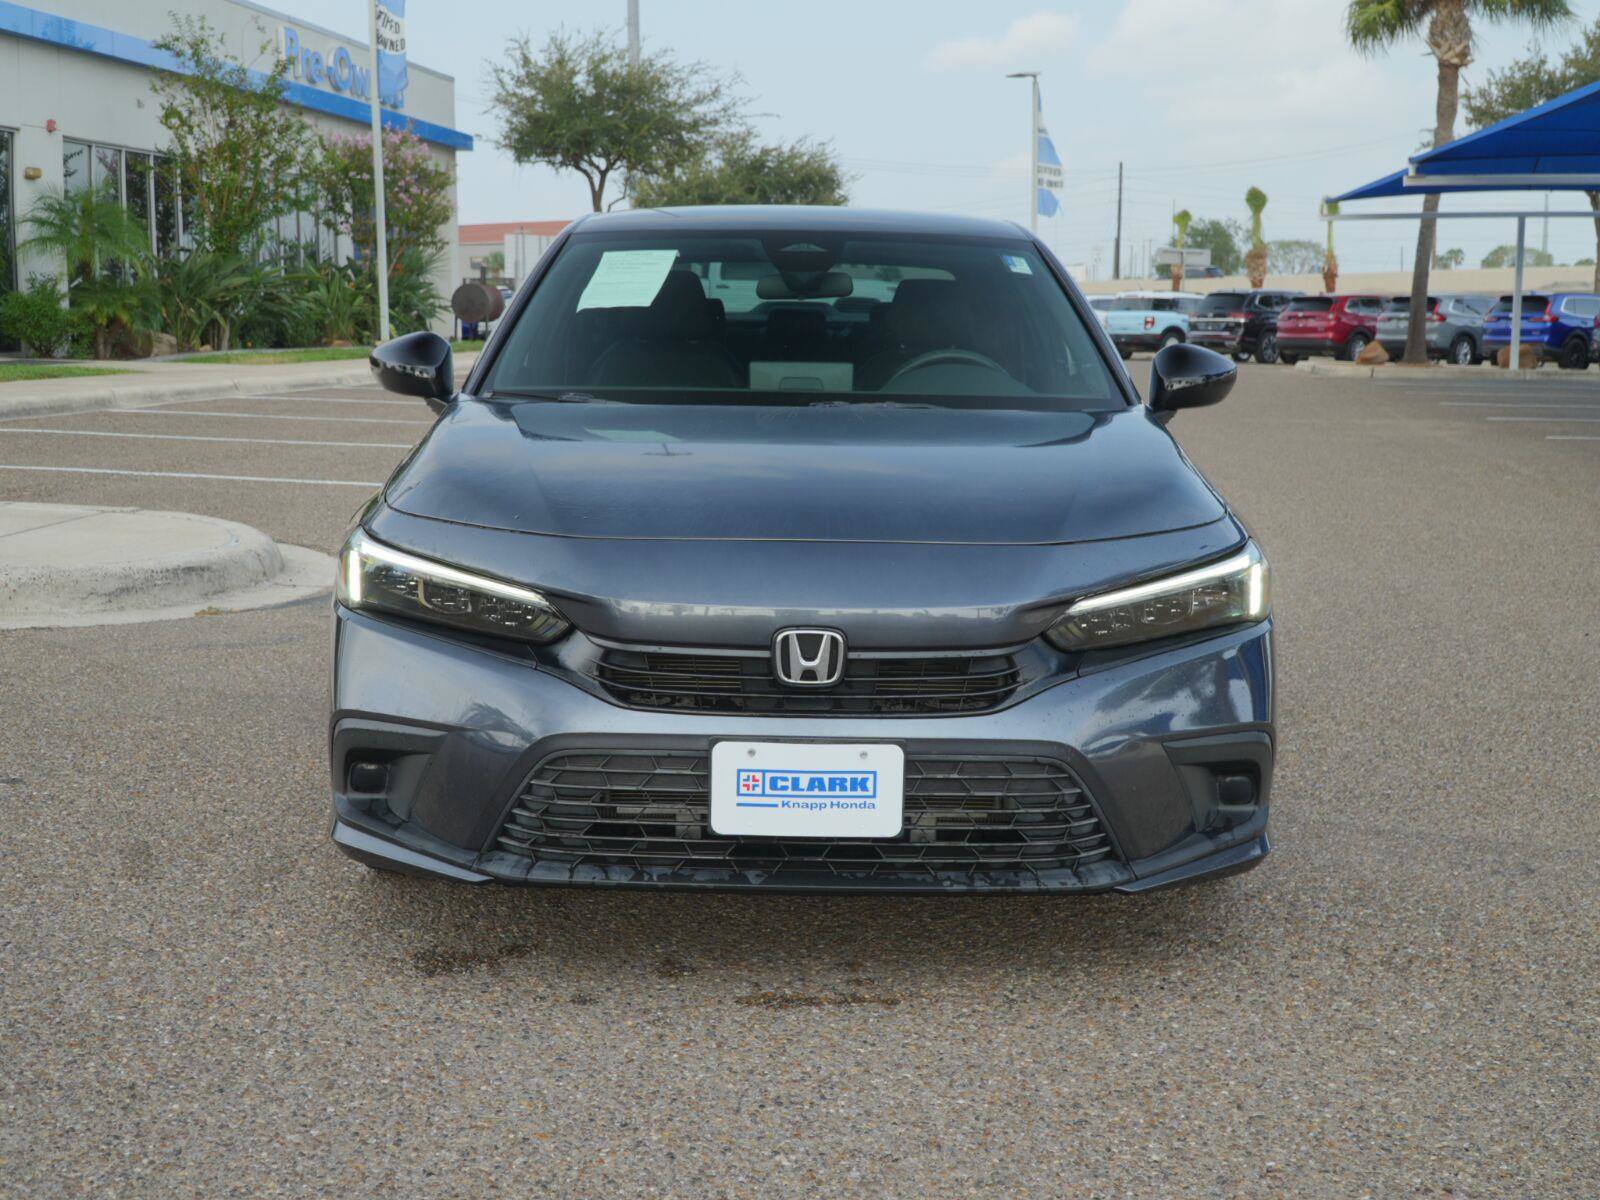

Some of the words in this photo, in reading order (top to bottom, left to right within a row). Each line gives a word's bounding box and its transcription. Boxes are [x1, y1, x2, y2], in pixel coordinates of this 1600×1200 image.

[278, 26, 371, 99] Pre-Ow
[768, 775, 870, 793] CLARK
[781, 799, 827, 811] Knapp
[829, 800, 876, 810] Honda
